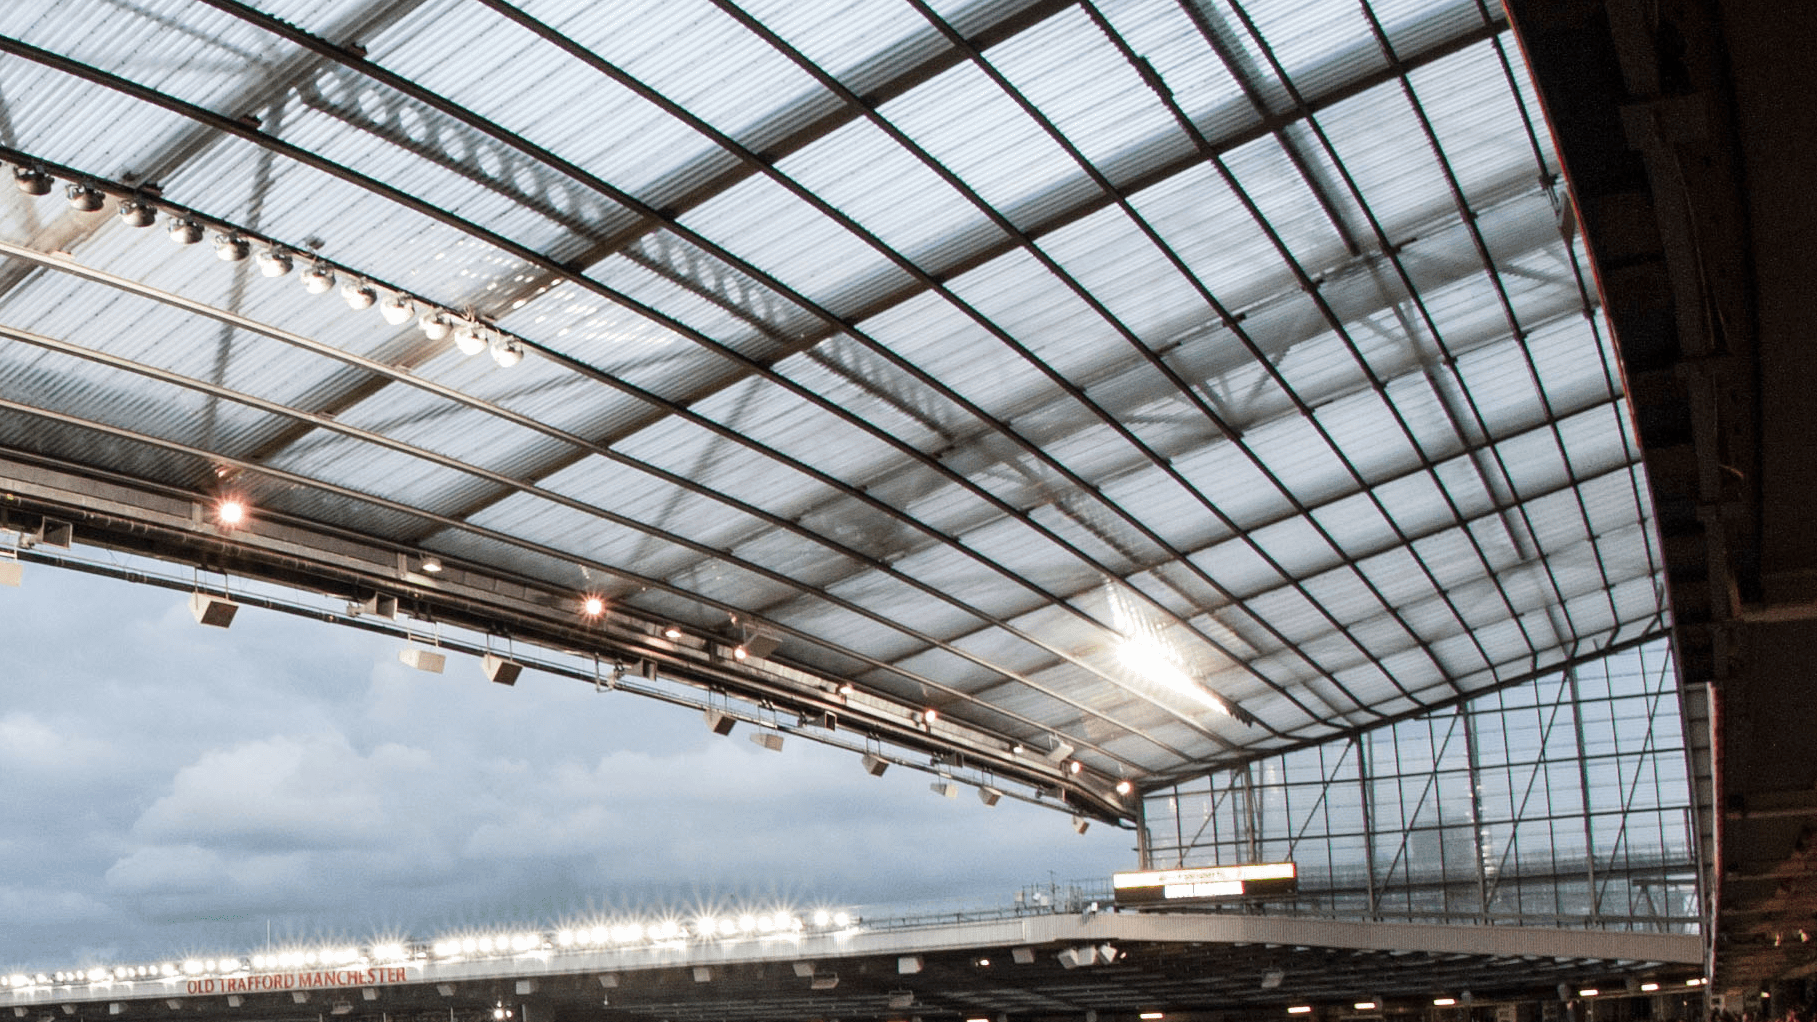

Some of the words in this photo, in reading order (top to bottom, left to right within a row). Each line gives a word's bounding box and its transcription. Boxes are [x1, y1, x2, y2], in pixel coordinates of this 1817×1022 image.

[187, 979, 215, 994] OLD
[219, 973, 295, 993] TRAFFORD
[298, 967, 407, 988] MANCHESTER
